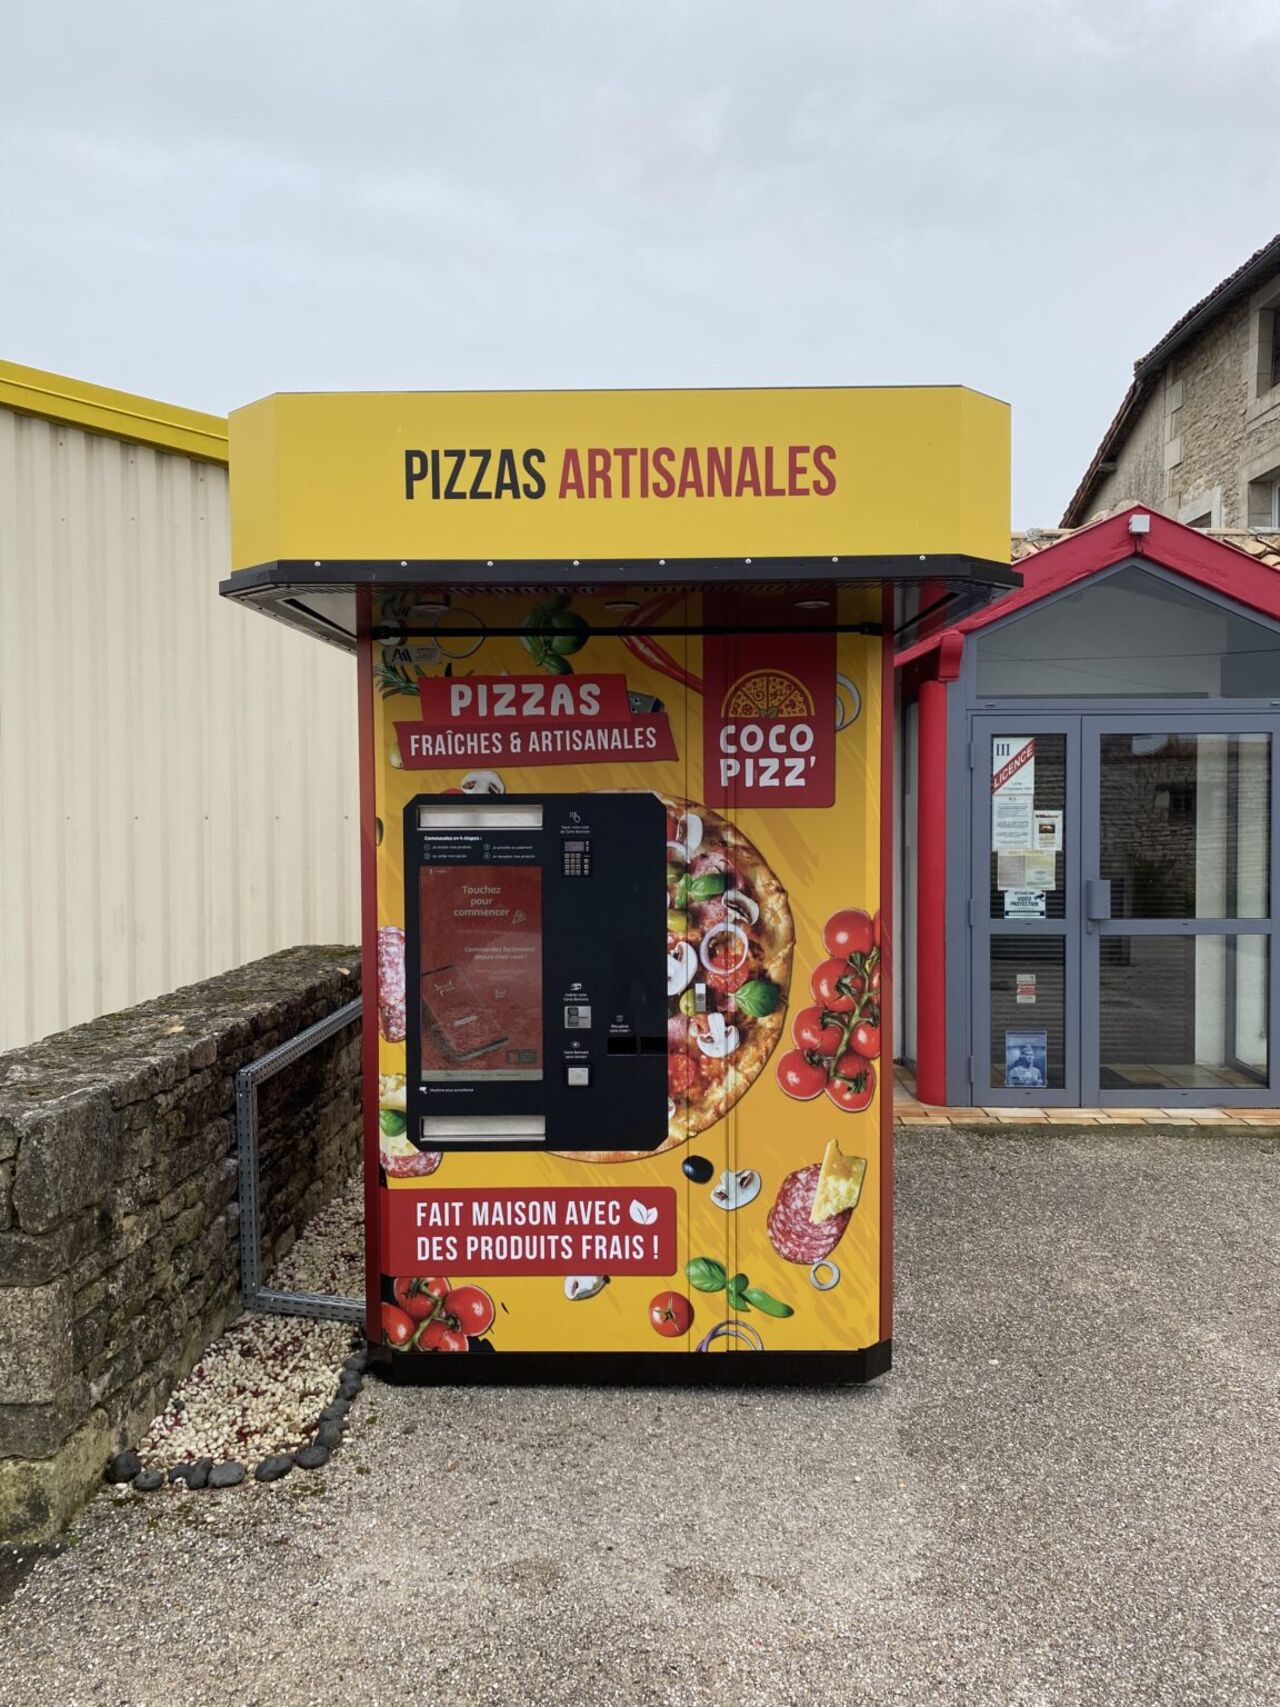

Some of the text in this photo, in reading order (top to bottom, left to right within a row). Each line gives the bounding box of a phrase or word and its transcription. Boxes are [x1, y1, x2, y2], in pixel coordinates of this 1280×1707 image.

[404, 444, 837, 500] PIZZAS ARTISANALES
[450, 683, 601, 717] PIZZAS
[410, 727, 657, 757] FRAÎCHES & ARTISANALES
[719, 723, 815, 754] COCO
[996, 743, 1010, 756] III
[719, 755, 817, 787] PIZZ'
[993, 743, 1034, 788] LICENCE
[462, 885, 502, 895] Touchez
[470, 897, 493, 906] pour
[453, 908, 510, 917] commencer
[416, 1200, 621, 1227] FAIT MAISON AVEC
[417, 1234, 659, 1261] DES PRODUITS FRAIS !
